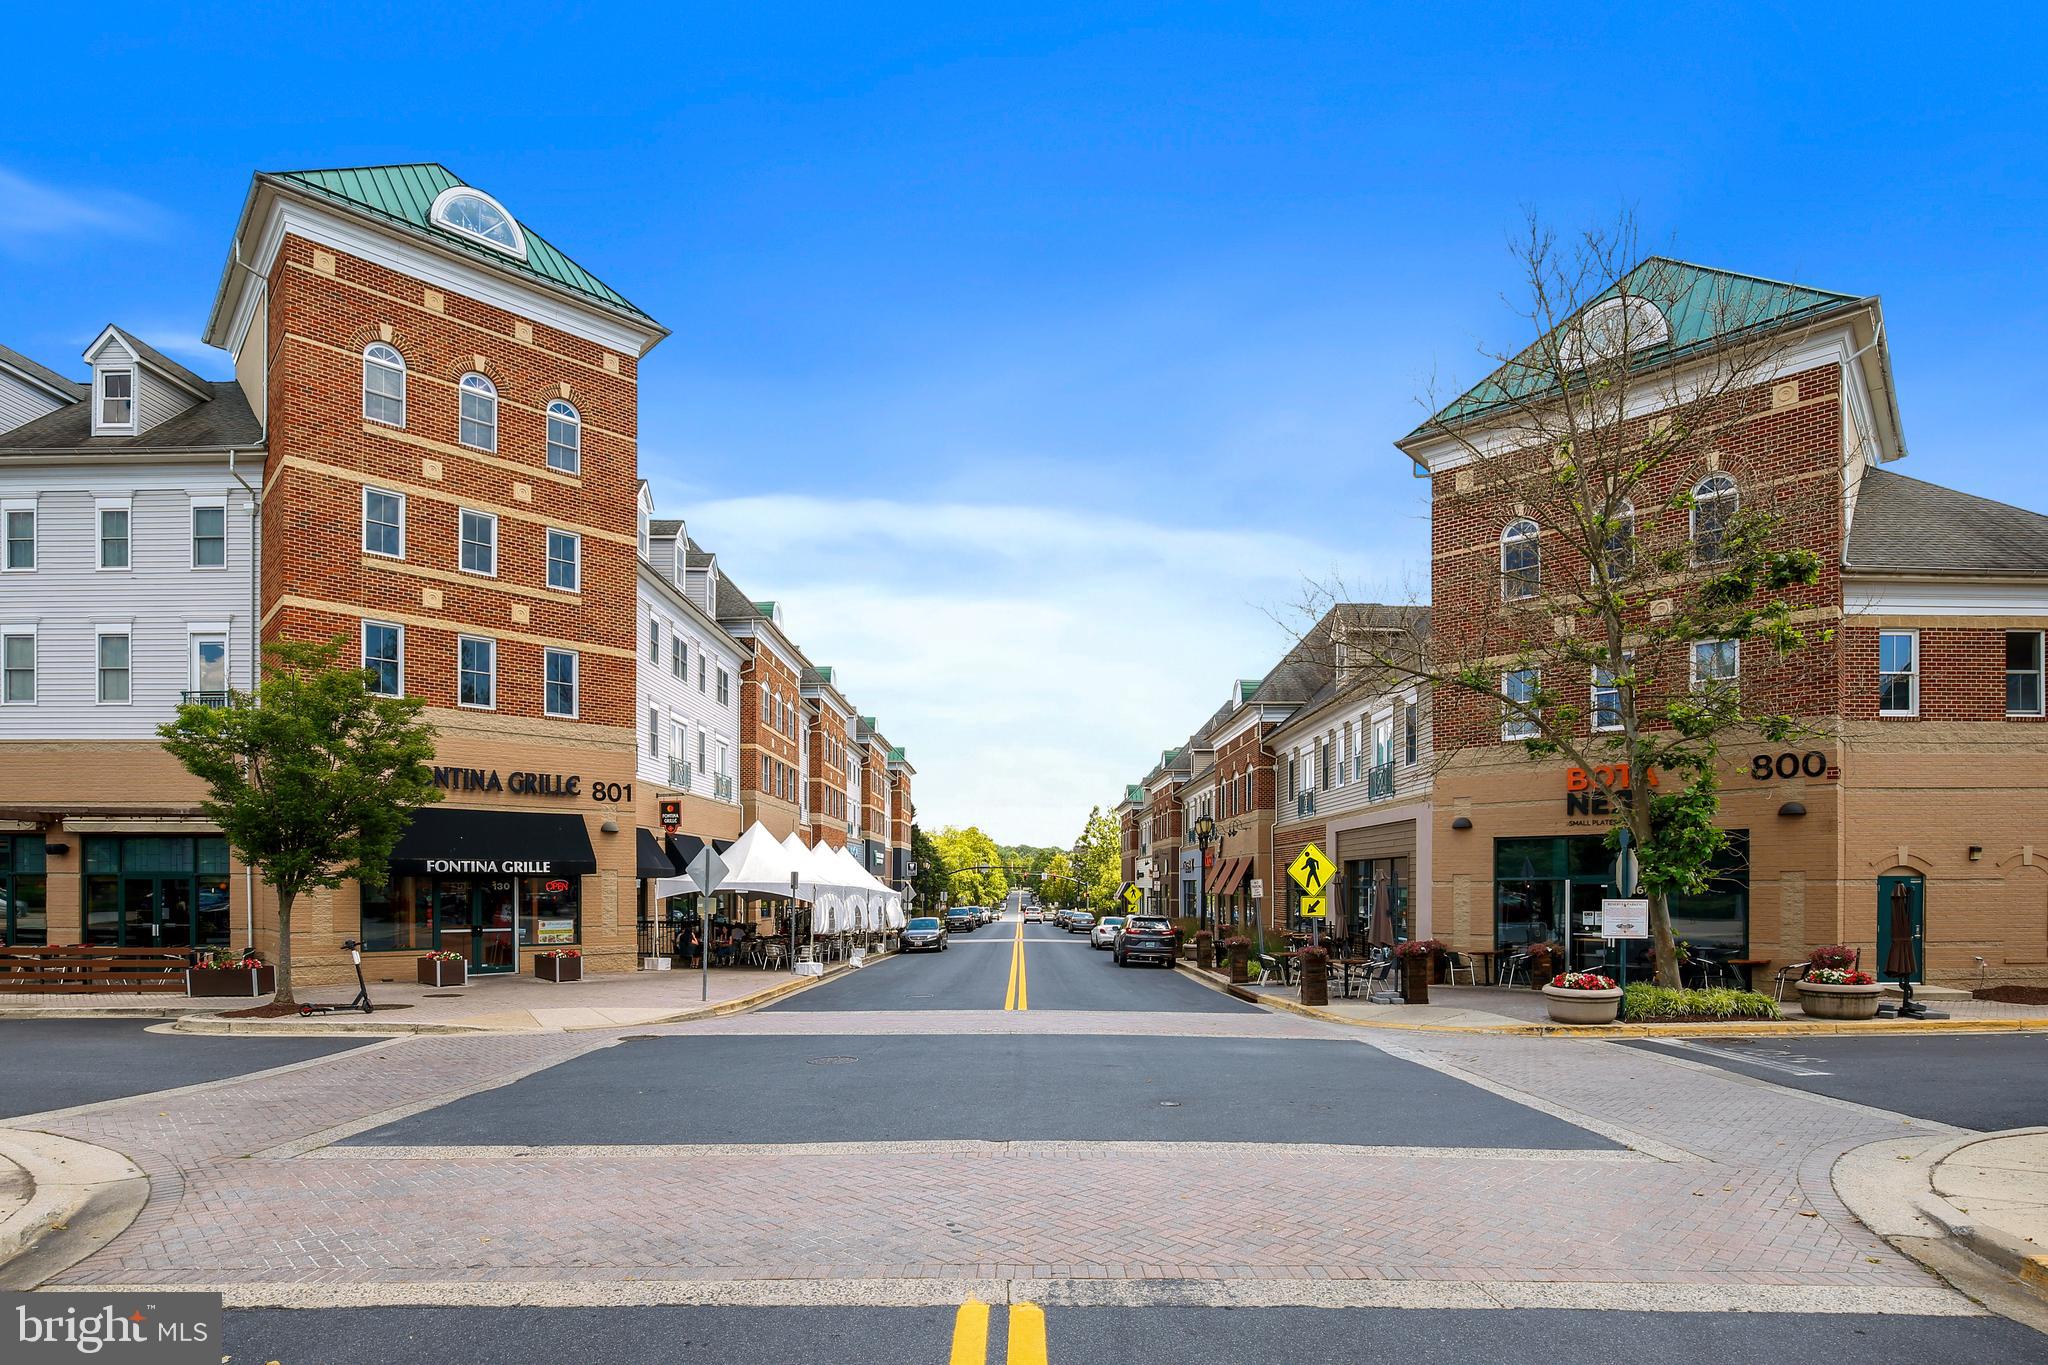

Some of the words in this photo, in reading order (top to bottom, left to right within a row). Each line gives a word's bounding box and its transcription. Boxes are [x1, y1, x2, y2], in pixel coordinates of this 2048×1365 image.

[1752, 750, 1827, 781] 800
[429, 766, 504, 792] NTINA
[508, 771, 581, 796] GRILLE
[592, 781, 632, 803] 801
[426, 860, 498, 873] FONTINA
[501, 861, 551, 873] GRILLE
[545, 880, 568, 892] OPEN
